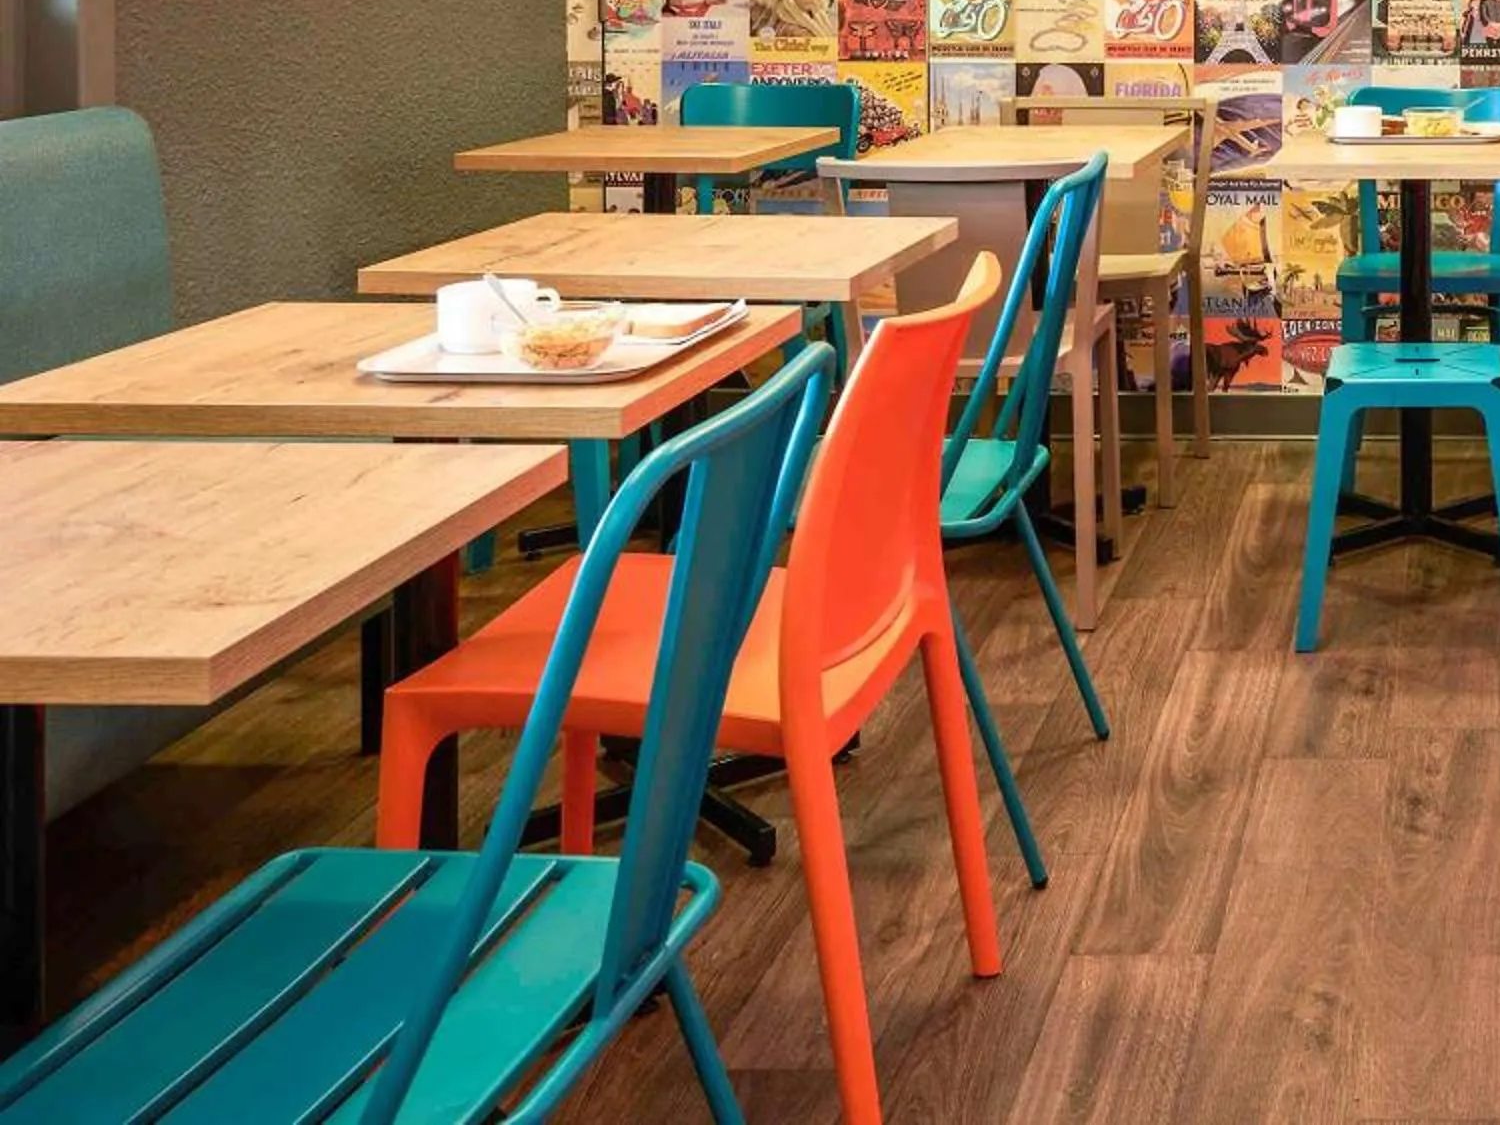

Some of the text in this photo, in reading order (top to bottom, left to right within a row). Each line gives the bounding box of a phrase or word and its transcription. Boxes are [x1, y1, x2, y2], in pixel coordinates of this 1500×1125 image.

[754, 41, 772, 52] The
[774, 37, 811, 52] Chief
[752, 63, 812, 75] EXETER
[1114, 81, 1182, 97] FLORIDA
[1207, 193, 1280, 206] OYAL MAIL
